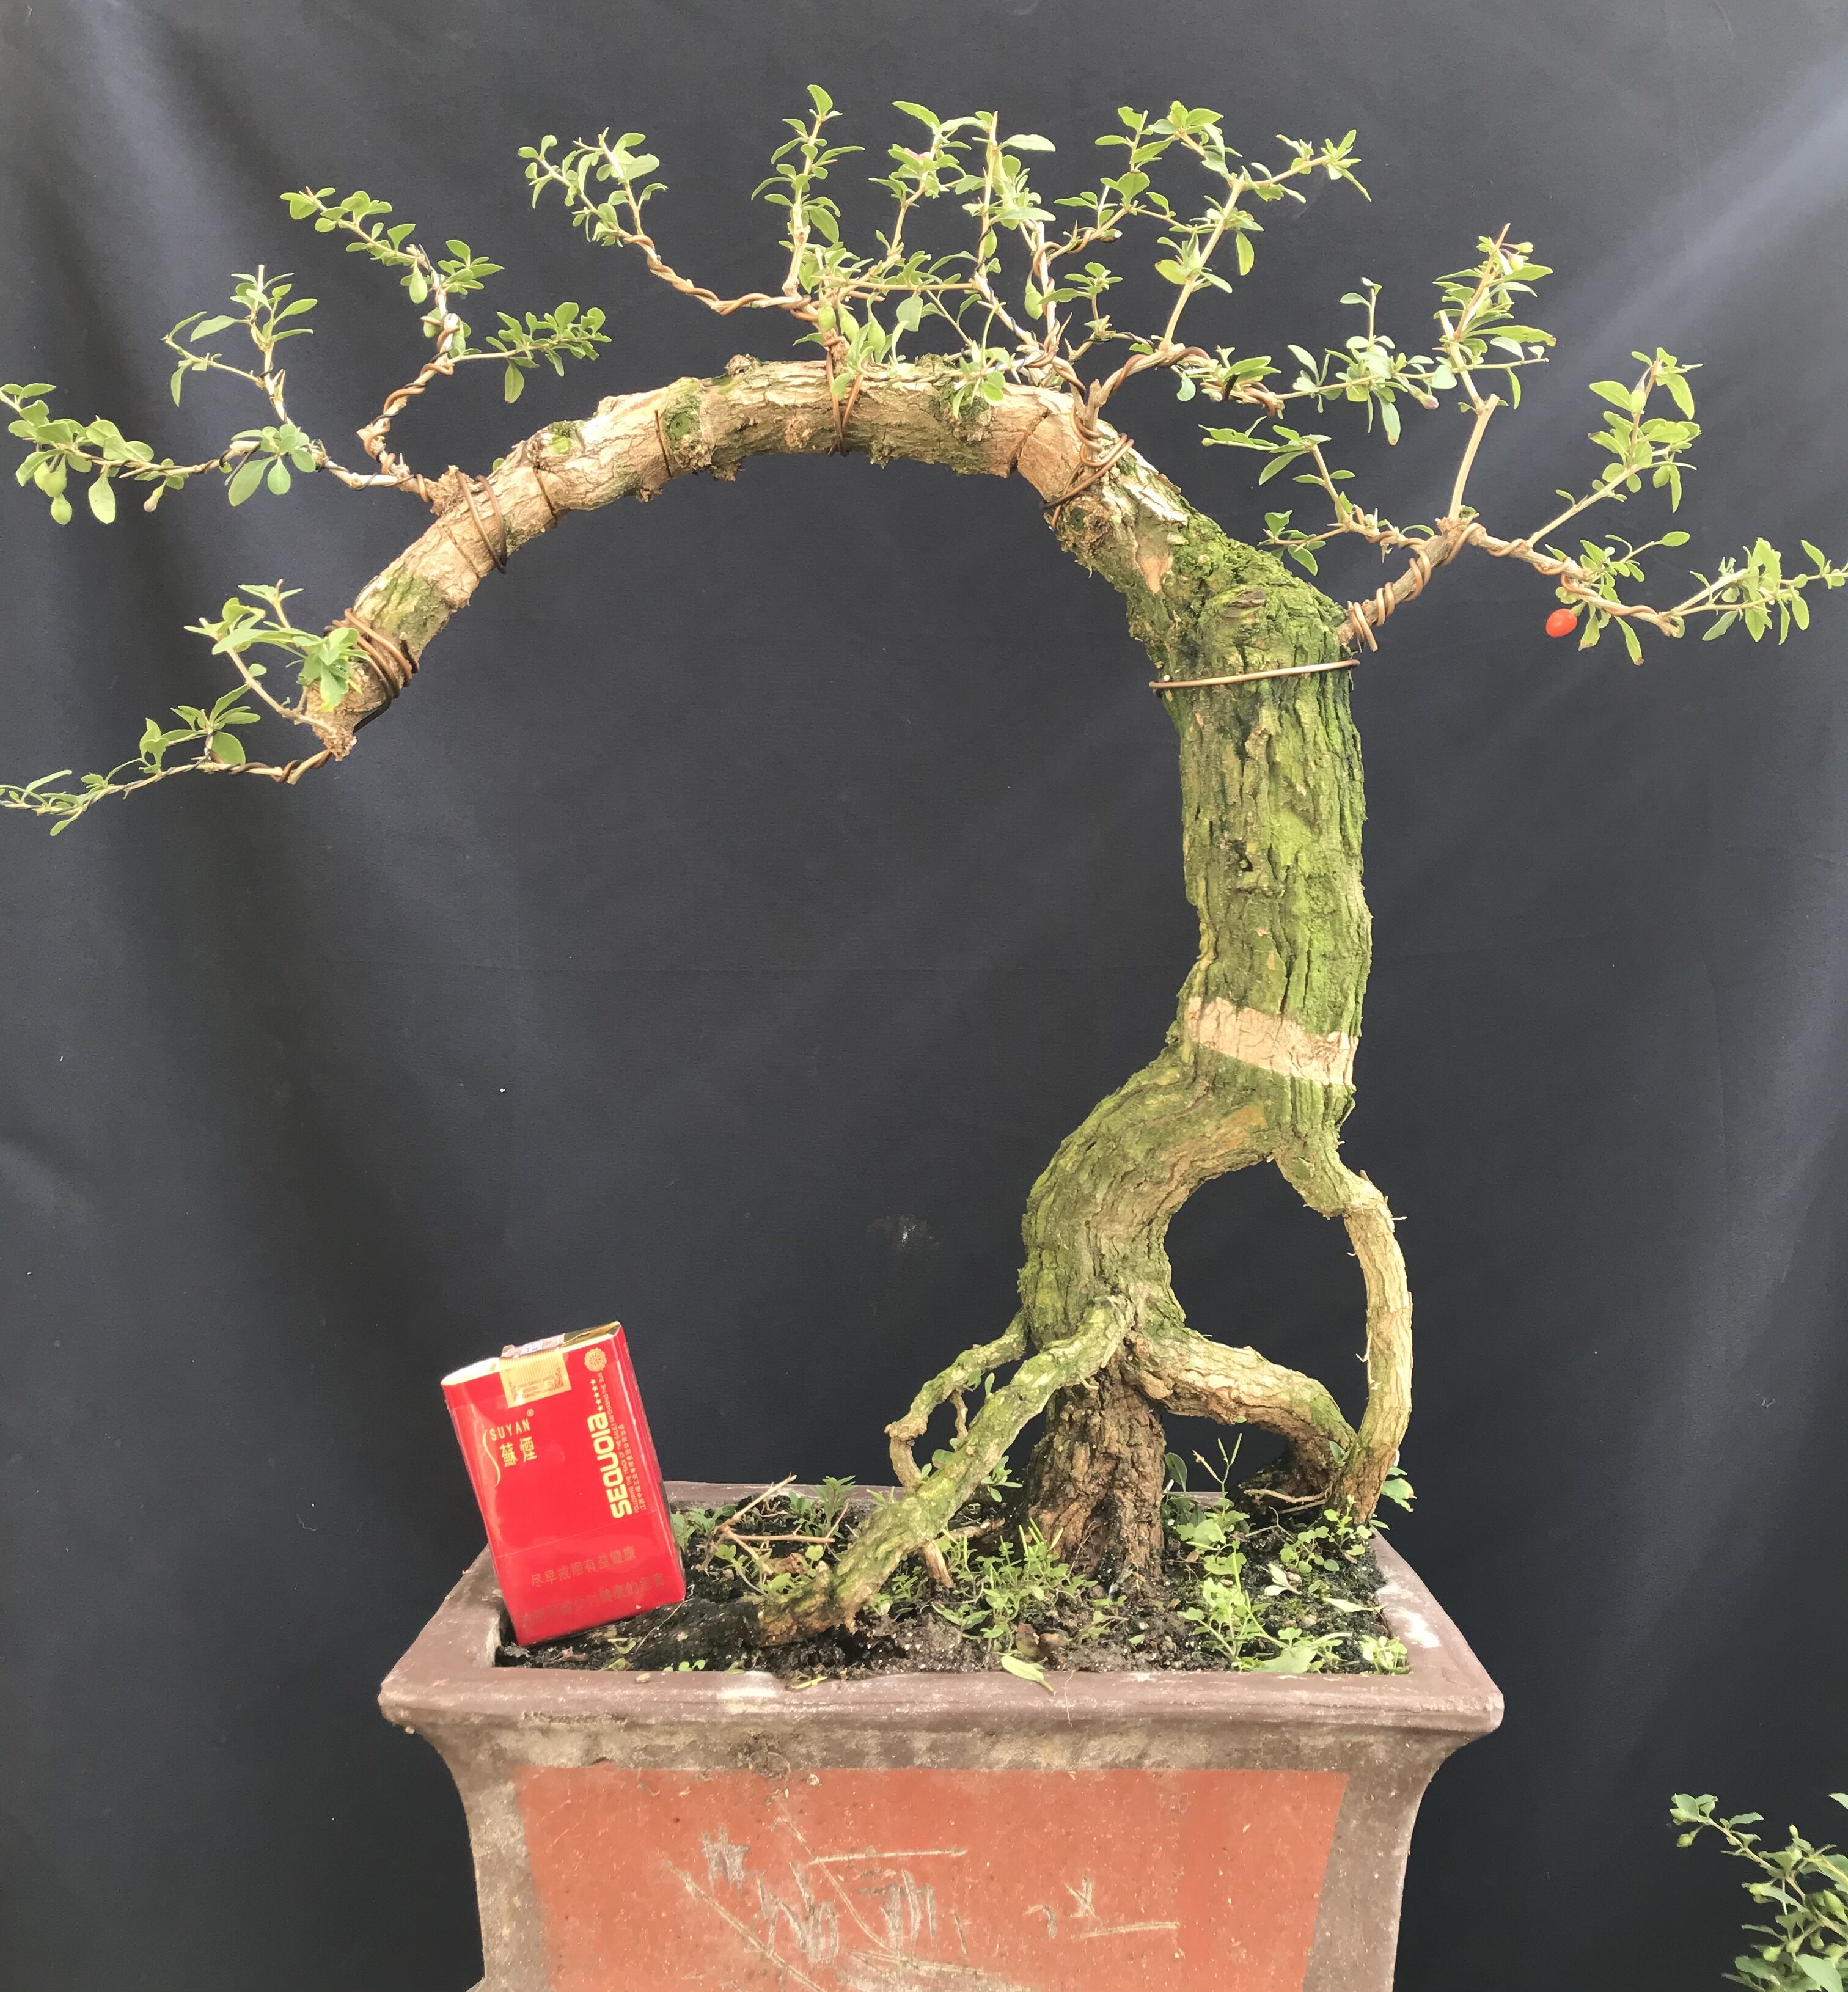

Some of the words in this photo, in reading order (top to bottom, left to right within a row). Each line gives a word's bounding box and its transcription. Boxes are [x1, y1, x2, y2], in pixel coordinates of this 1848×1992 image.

[489, 1418, 530, 1441] SUYAN
[500, 1437, 537, 1467] 蘇煙
[529, 1545, 637, 1589] 尽早戒烟有益健康
